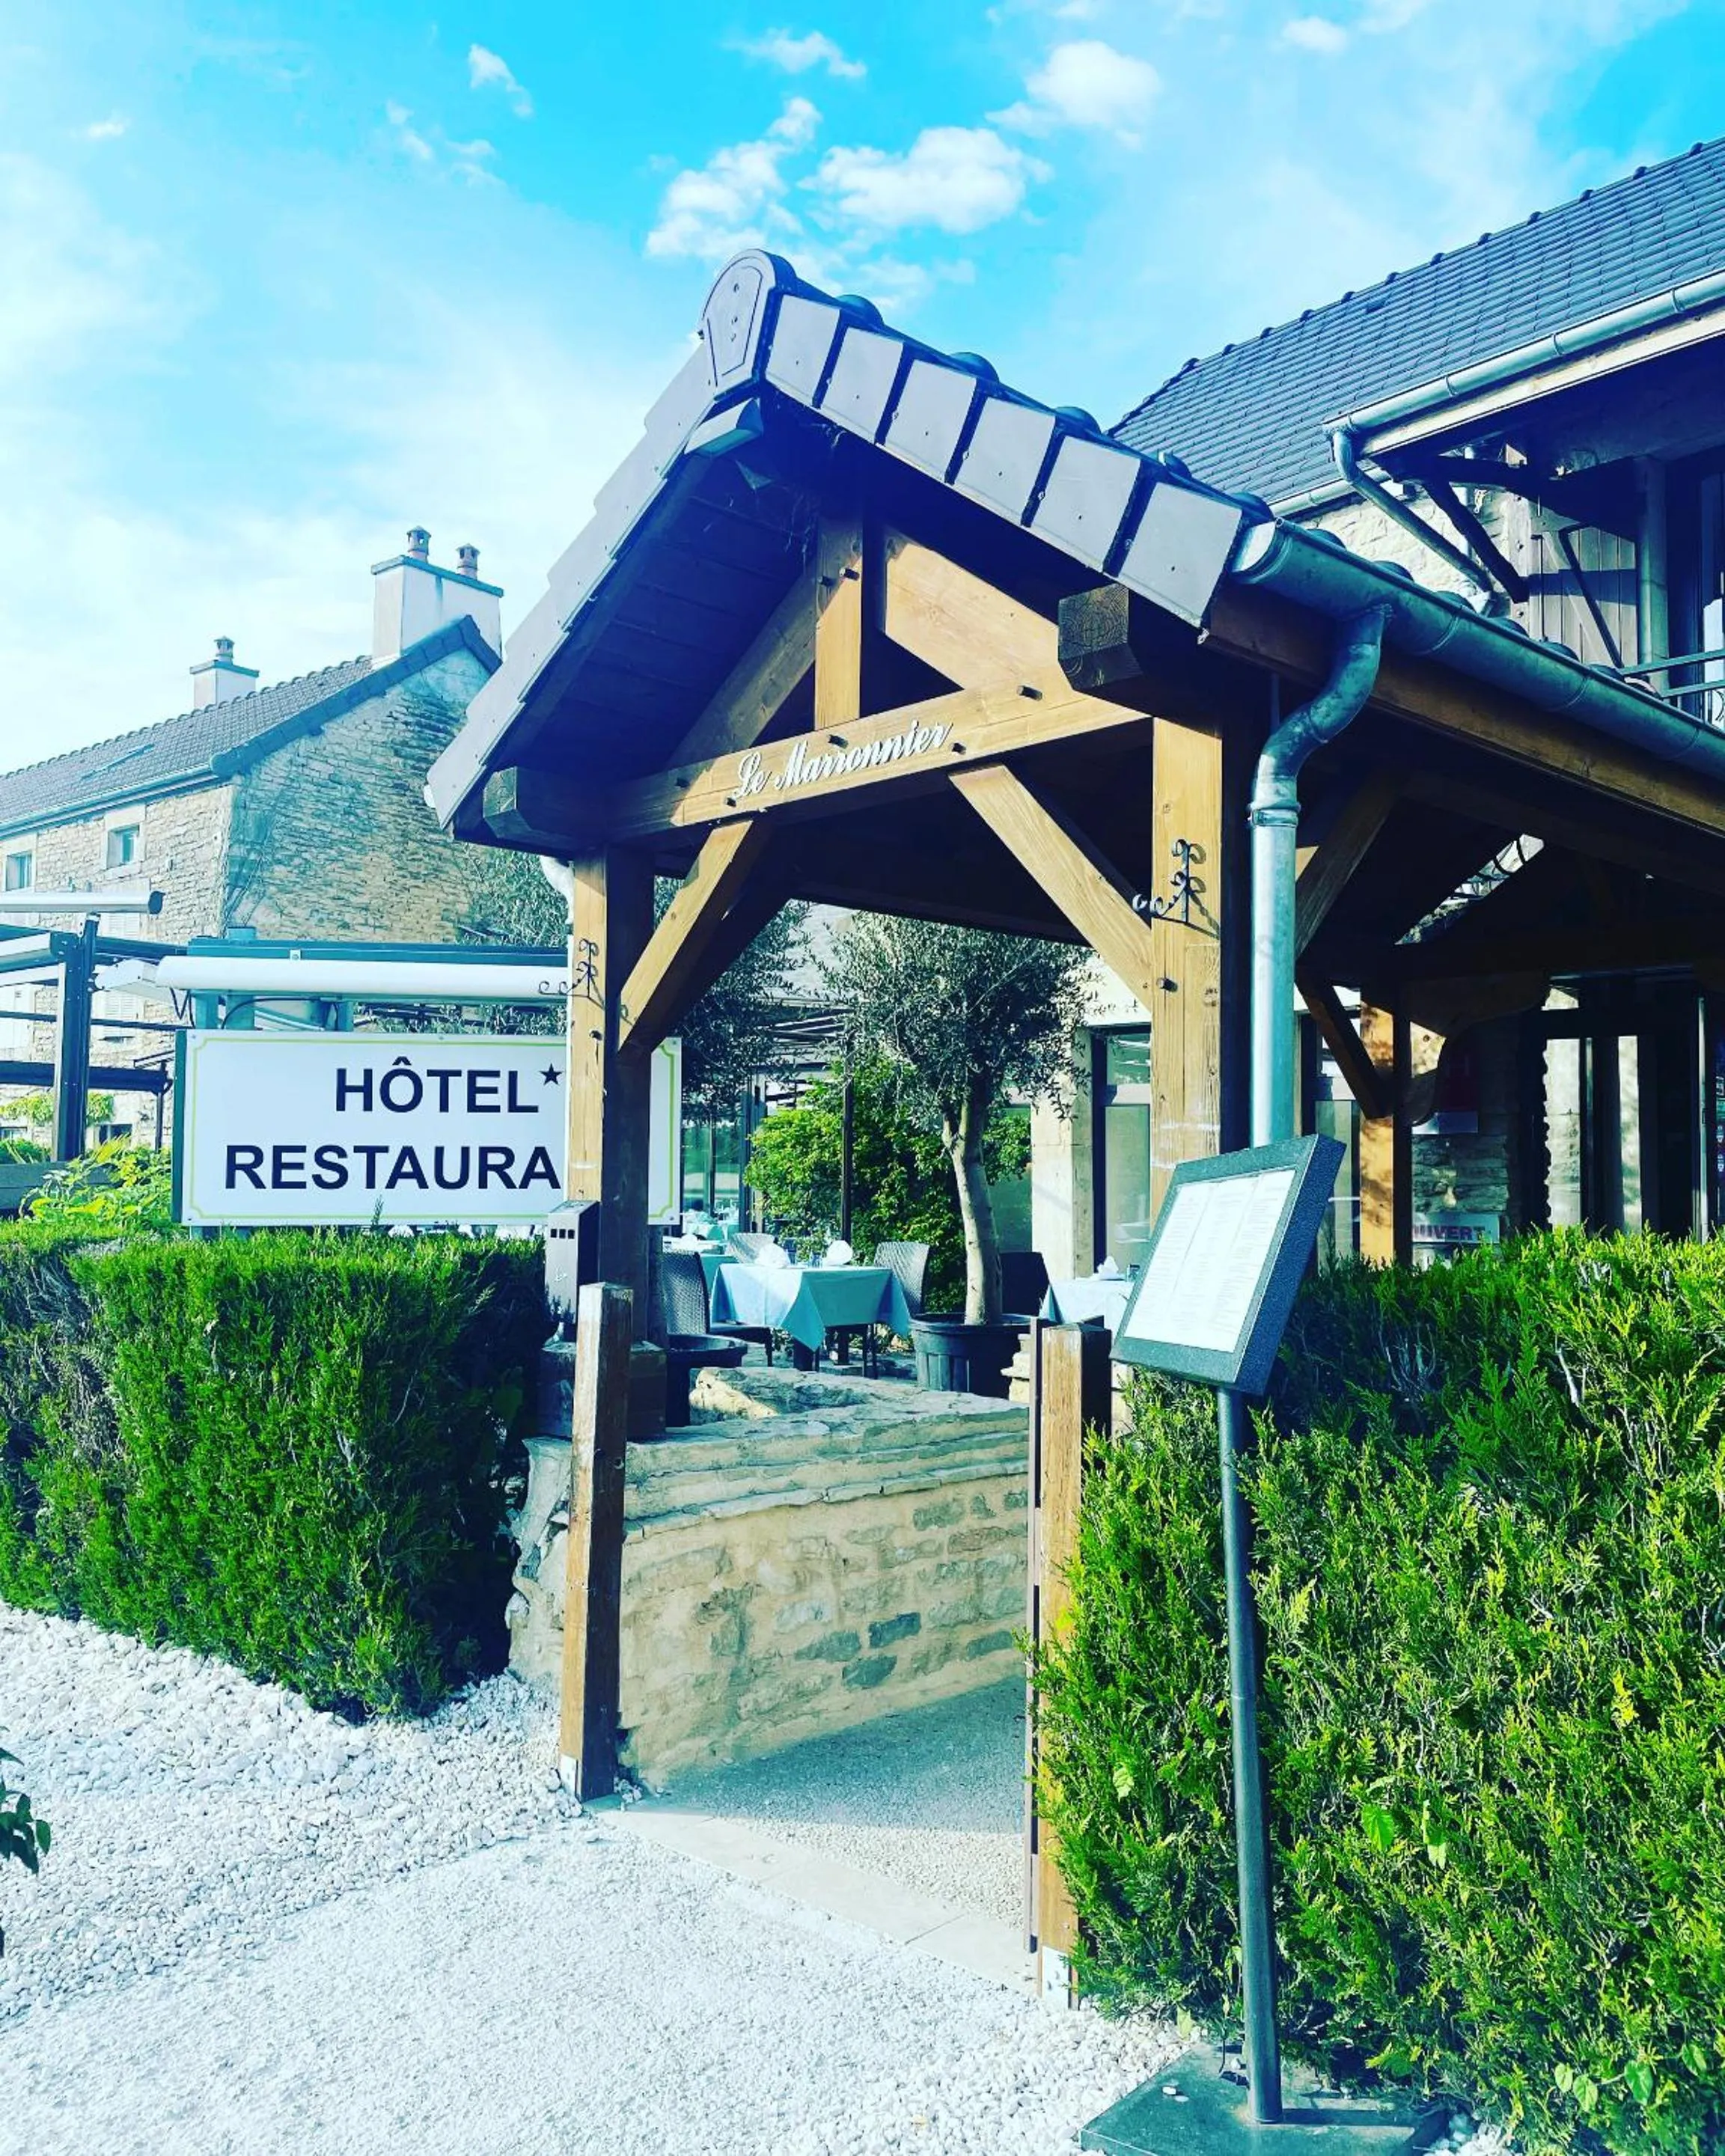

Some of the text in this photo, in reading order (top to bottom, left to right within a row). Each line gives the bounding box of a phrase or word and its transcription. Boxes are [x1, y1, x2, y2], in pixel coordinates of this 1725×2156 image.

[731, 719, 953, 798] Le Marronnier
[336, 1056, 539, 1113] HÔTEL
[226, 1145, 561, 1190] RESTAURA
